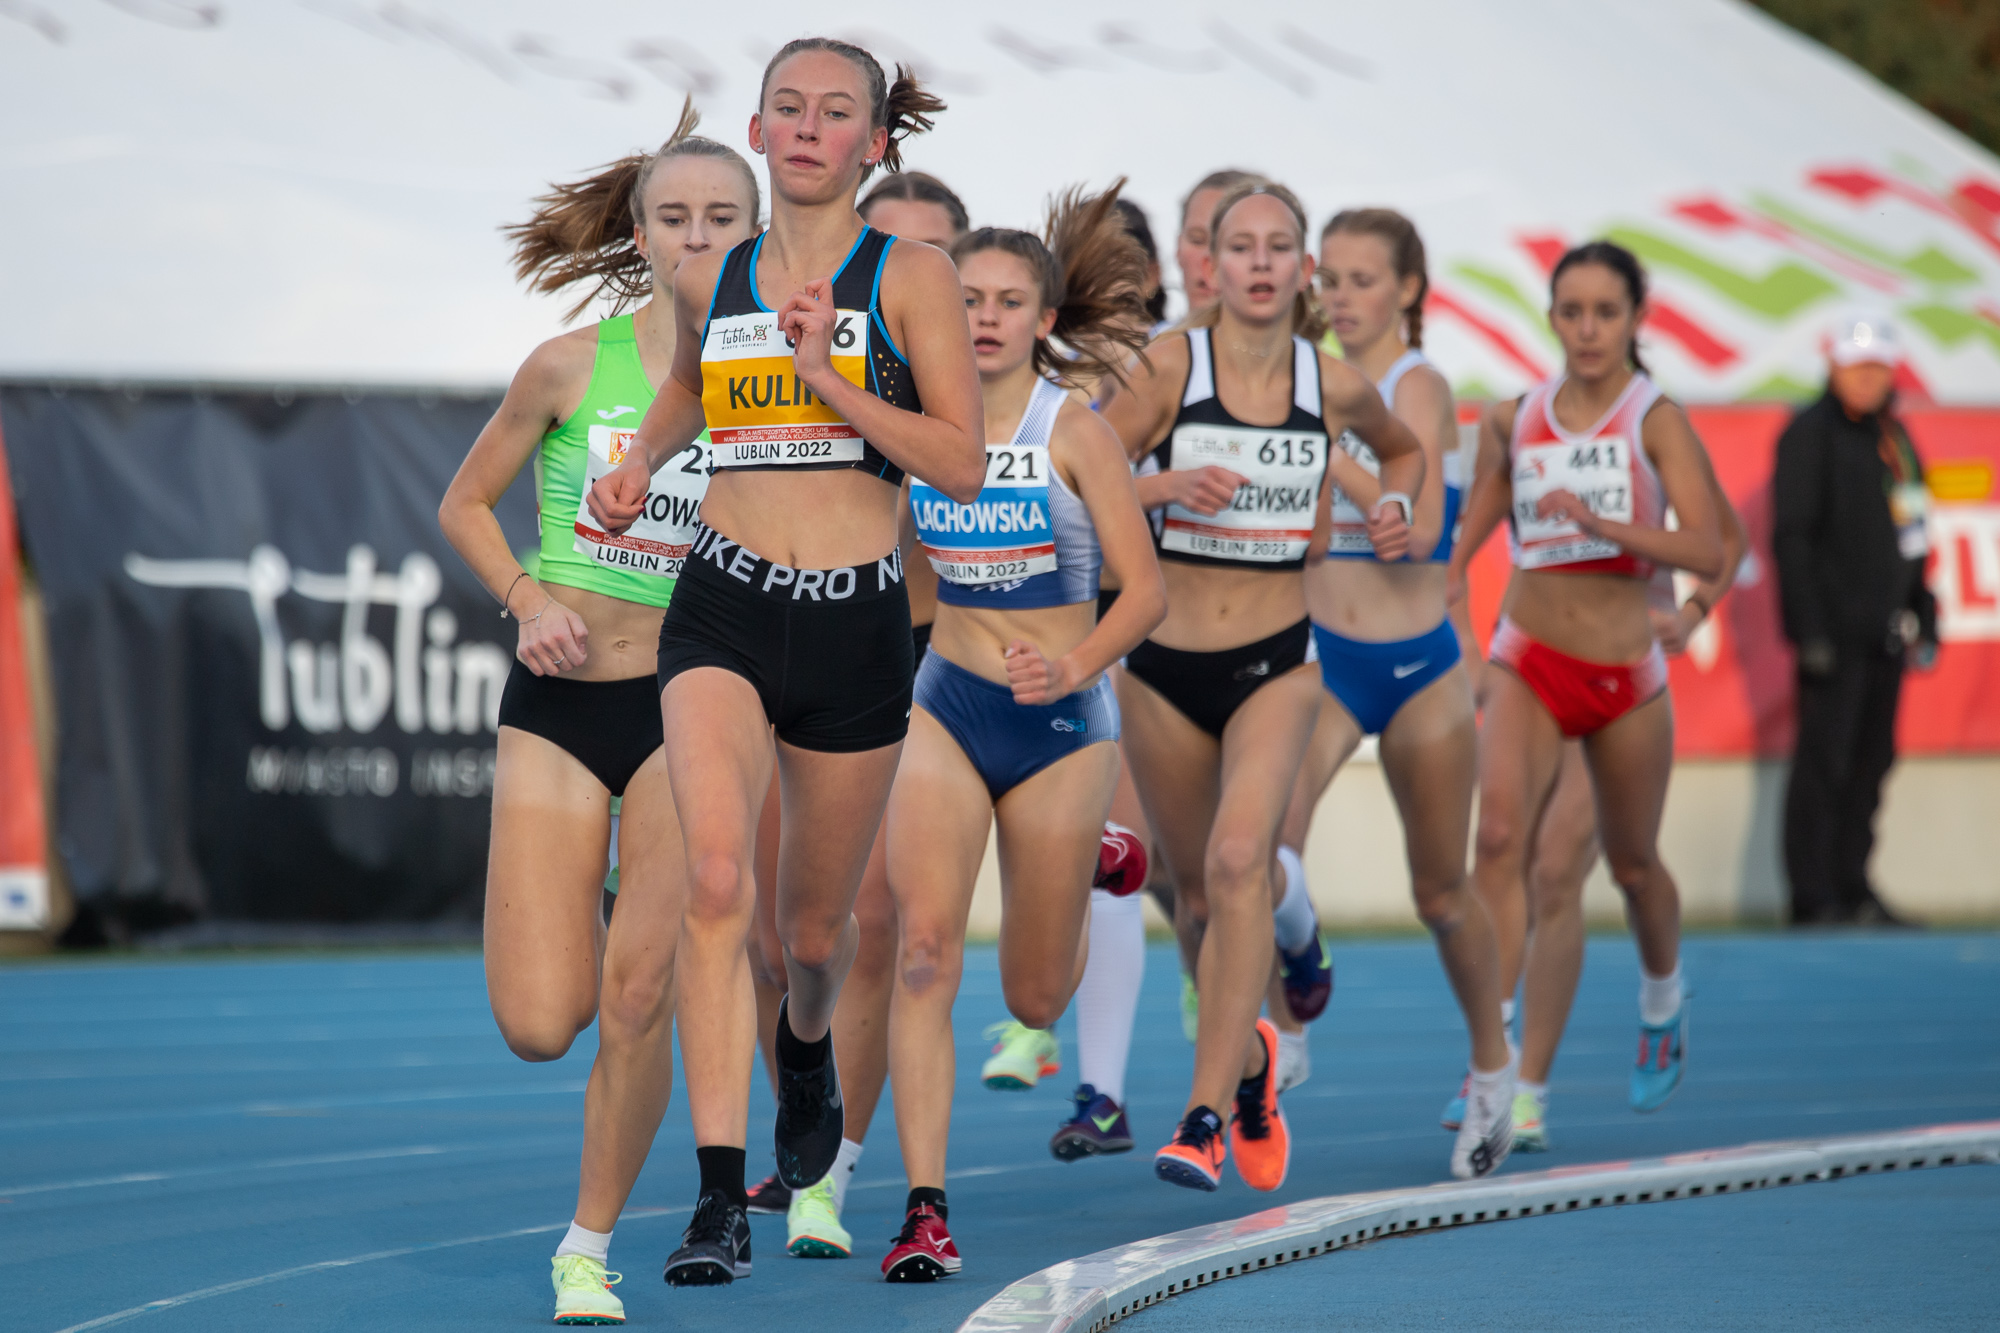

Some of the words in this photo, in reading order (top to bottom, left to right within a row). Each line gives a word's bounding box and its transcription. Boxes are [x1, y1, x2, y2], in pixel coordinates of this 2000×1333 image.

[735, 443, 780, 460] LUBLIN
[786, 441, 832, 458] 2022
[1258, 438, 1315, 467] 615
[1568, 446, 1617, 469] 441
[912, 500, 1047, 533] LACHOWSKA
[1190, 536, 1246, 554] LUBLIN
[1251, 542, 1289, 556] 2022
[596, 546, 659, 571] LUBLIN
[938, 562, 980, 579] LUBLIN
[985, 561, 1029, 578] 2022
[762, 563, 857, 601] PRO
